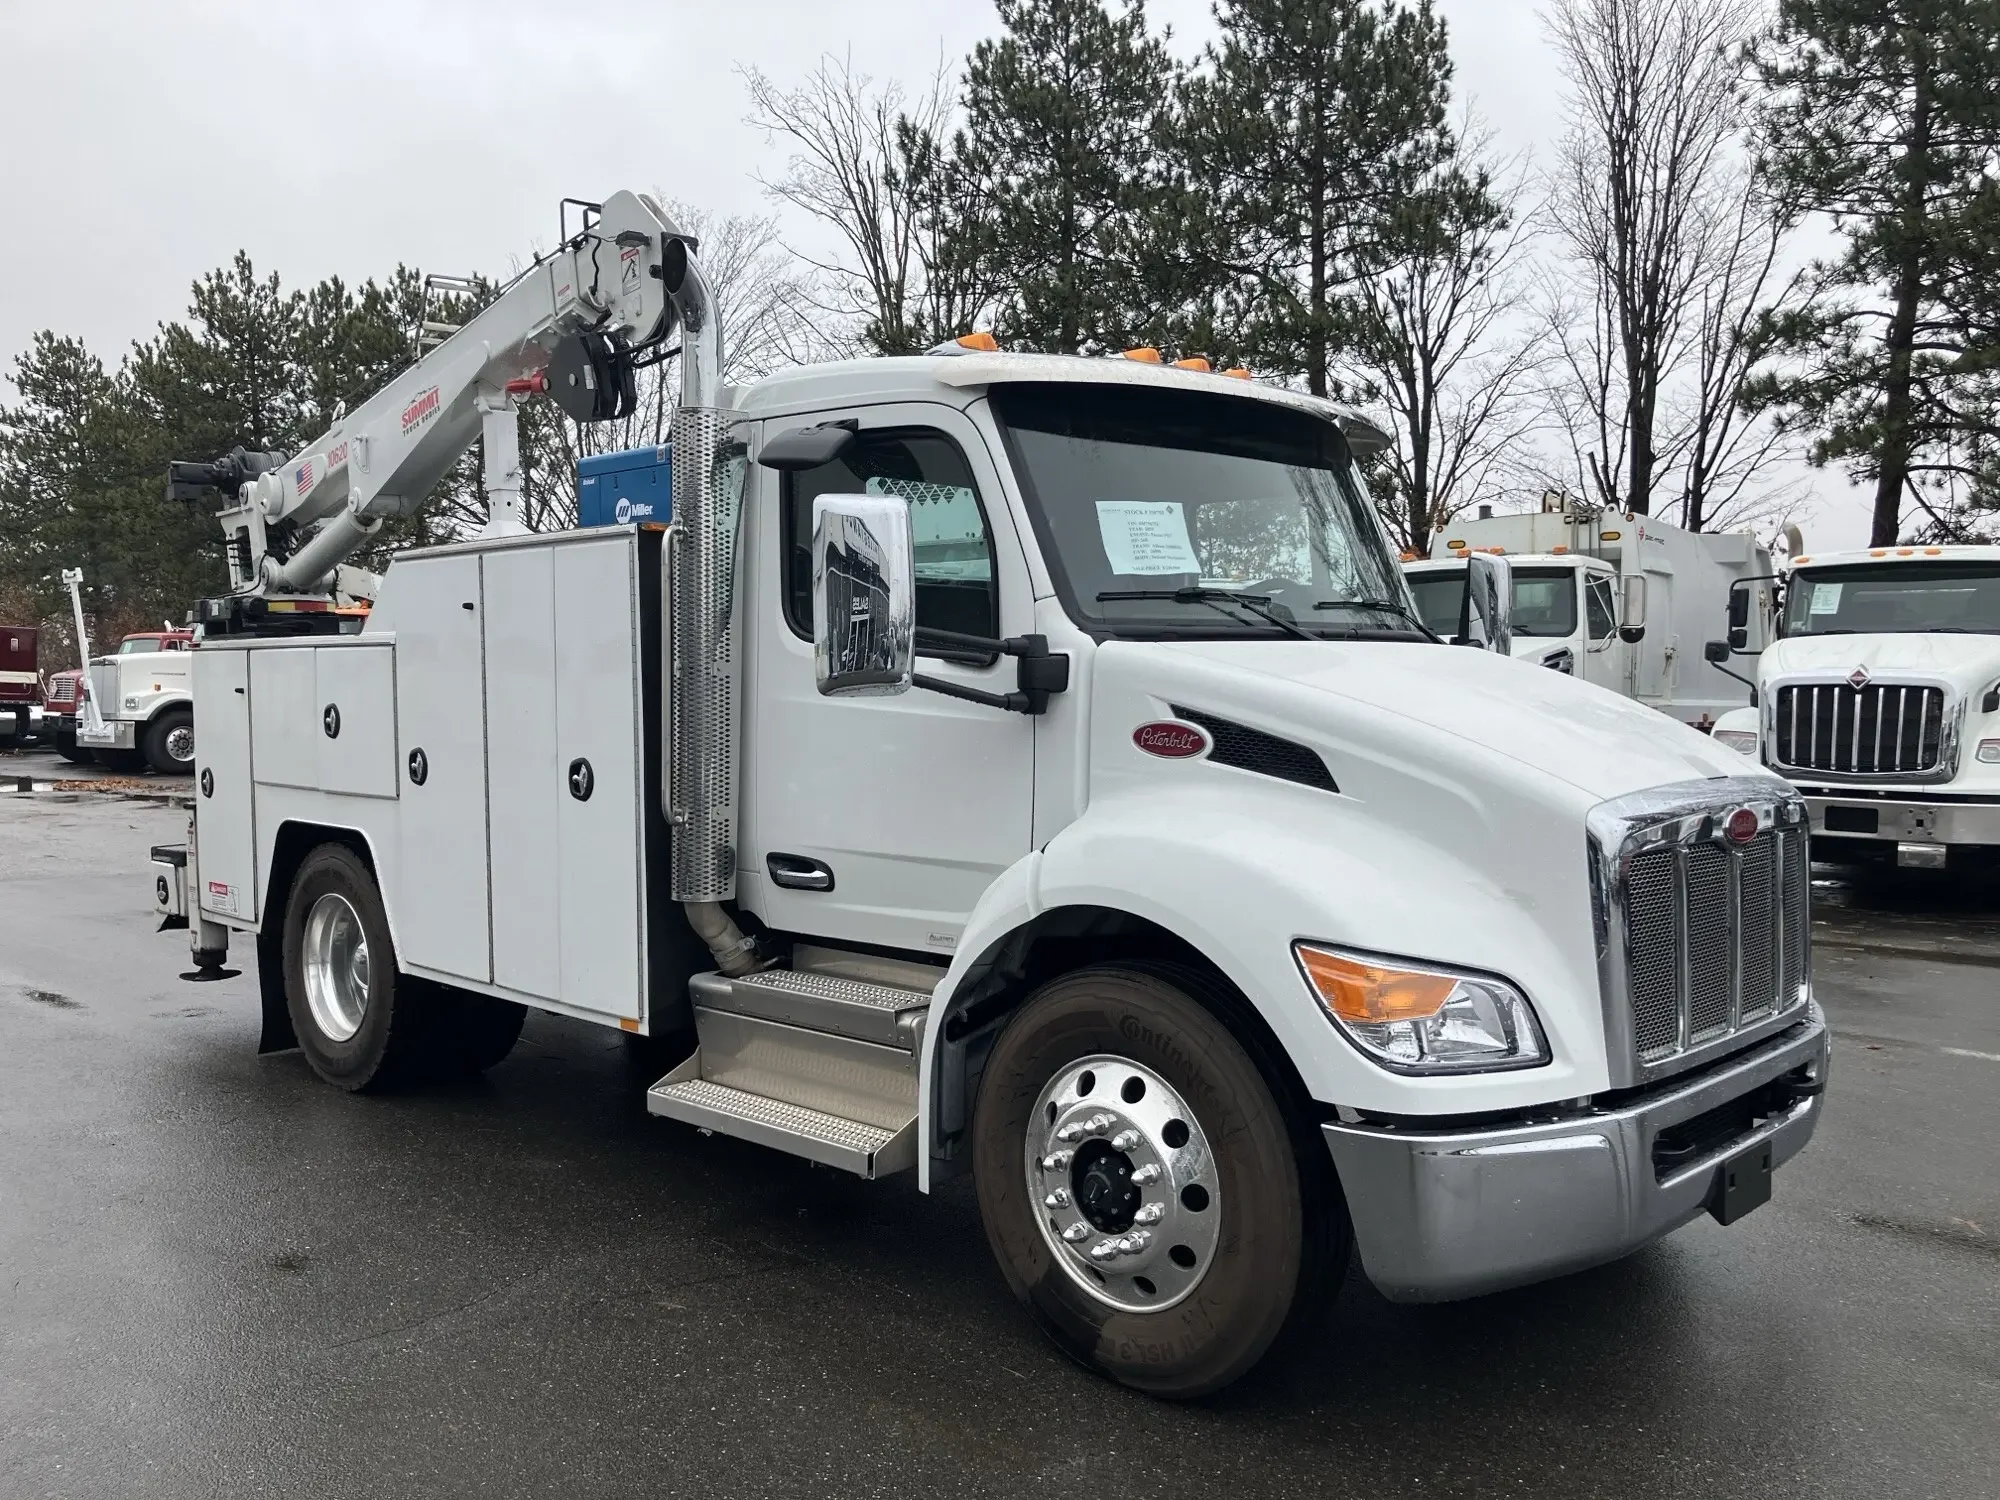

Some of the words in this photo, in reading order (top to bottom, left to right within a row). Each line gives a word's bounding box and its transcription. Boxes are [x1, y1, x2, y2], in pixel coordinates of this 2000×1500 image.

[401, 387, 439, 428] SUMMIT
[327, 440, 348, 468] 10620
[631, 503, 653, 517] Miller
[1140, 727, 1199, 749] Peterbilt
